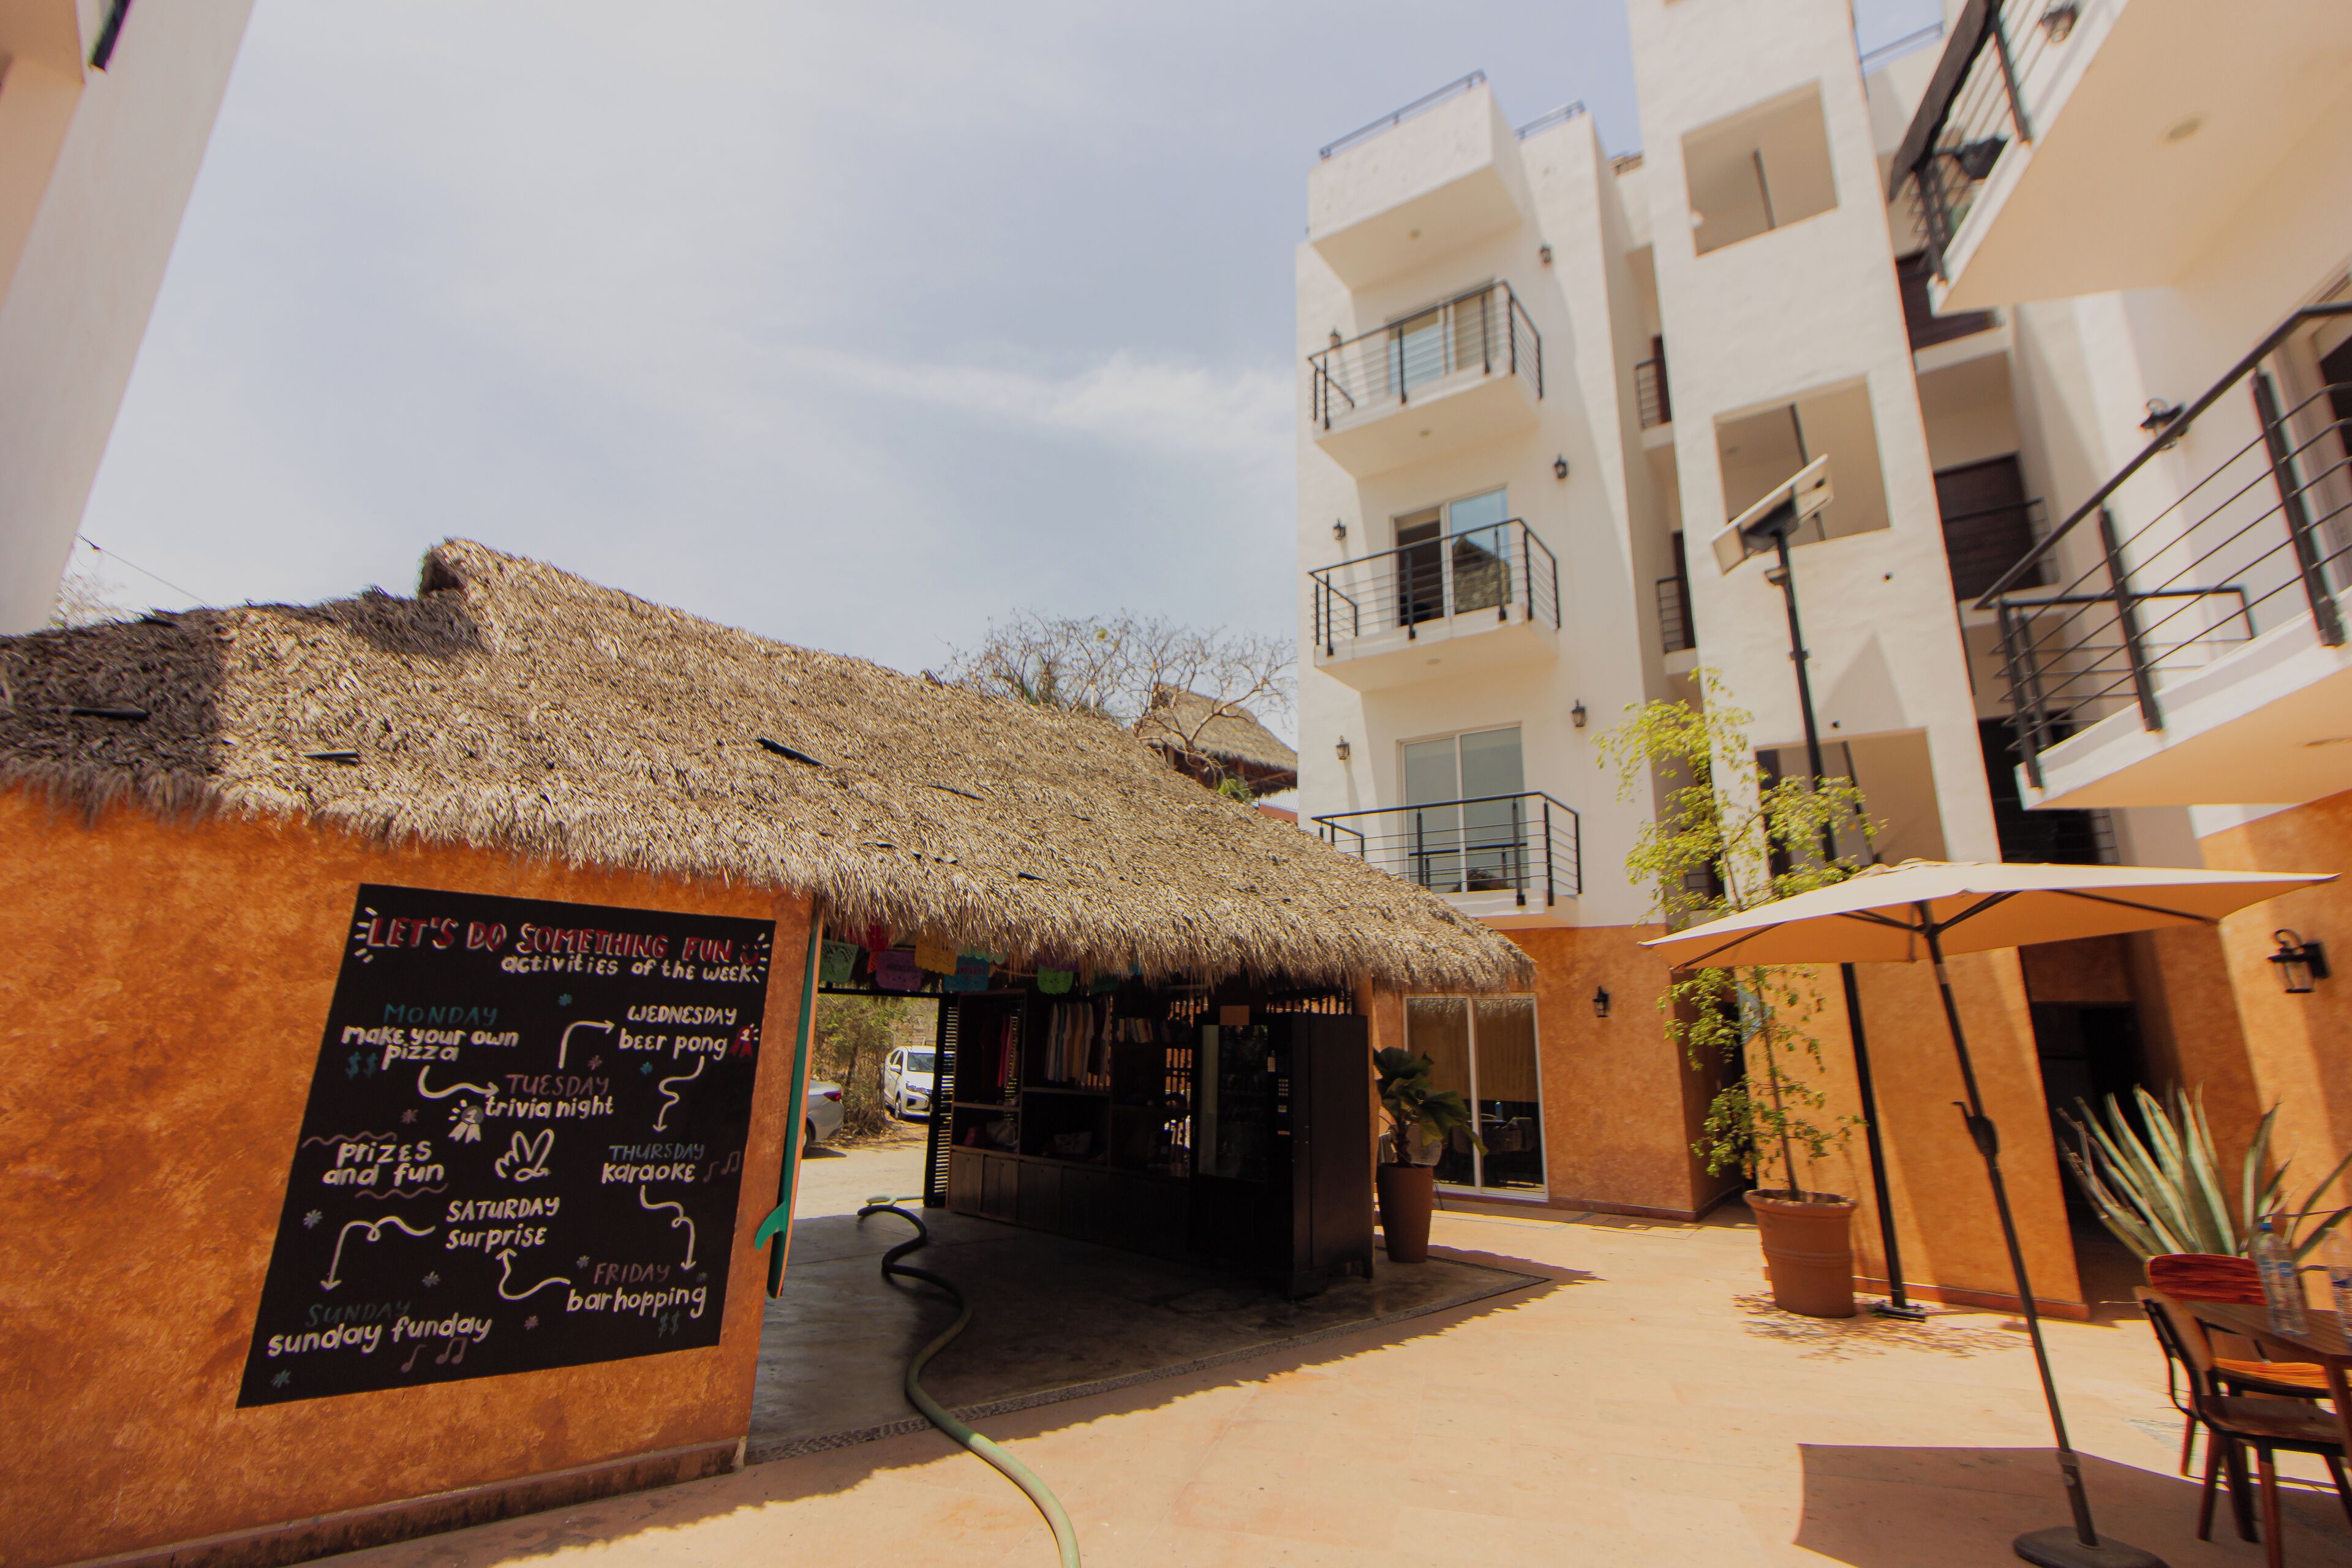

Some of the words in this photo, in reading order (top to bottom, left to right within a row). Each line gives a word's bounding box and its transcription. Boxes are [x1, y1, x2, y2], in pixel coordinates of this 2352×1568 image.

[367, 916, 459, 949] LET'S
[466, 921, 507, 952] DO
[515, 922, 668, 959] SOMETHING
[682, 937, 734, 963] FUN
[500, 954, 619, 976] activities
[630, 959, 657, 976] of
[662, 959, 696, 981] the
[383, 1003, 499, 1027] MONDAY
[627, 1005, 738, 1026] WEDNESDAY
[409, 1027, 467, 1046] your
[470, 1030, 520, 1048] own
[618, 1027, 668, 1052] beer
[672, 1035, 729, 1061] pong
[380, 1043, 460, 1072] pizza
[504, 1074, 609, 1098] TUESDAY
[484, 1095, 552, 1120] trivia
[554, 1094, 614, 1120] night
[336, 1140, 433, 1169] prizes
[608, 1143, 705, 1162] THURSDAY
[322, 1164, 381, 1187] and
[393, 1163, 446, 1188] fun
[445, 1196, 561, 1223] SATURDAY
[444, 1223, 548, 1254] surprise
[593, 1262, 671, 1286] FRIDAY
[305, 1300, 412, 1328] SUNDAY
[266, 1322, 383, 1358] sunday
[390, 1311, 493, 1344] funday
